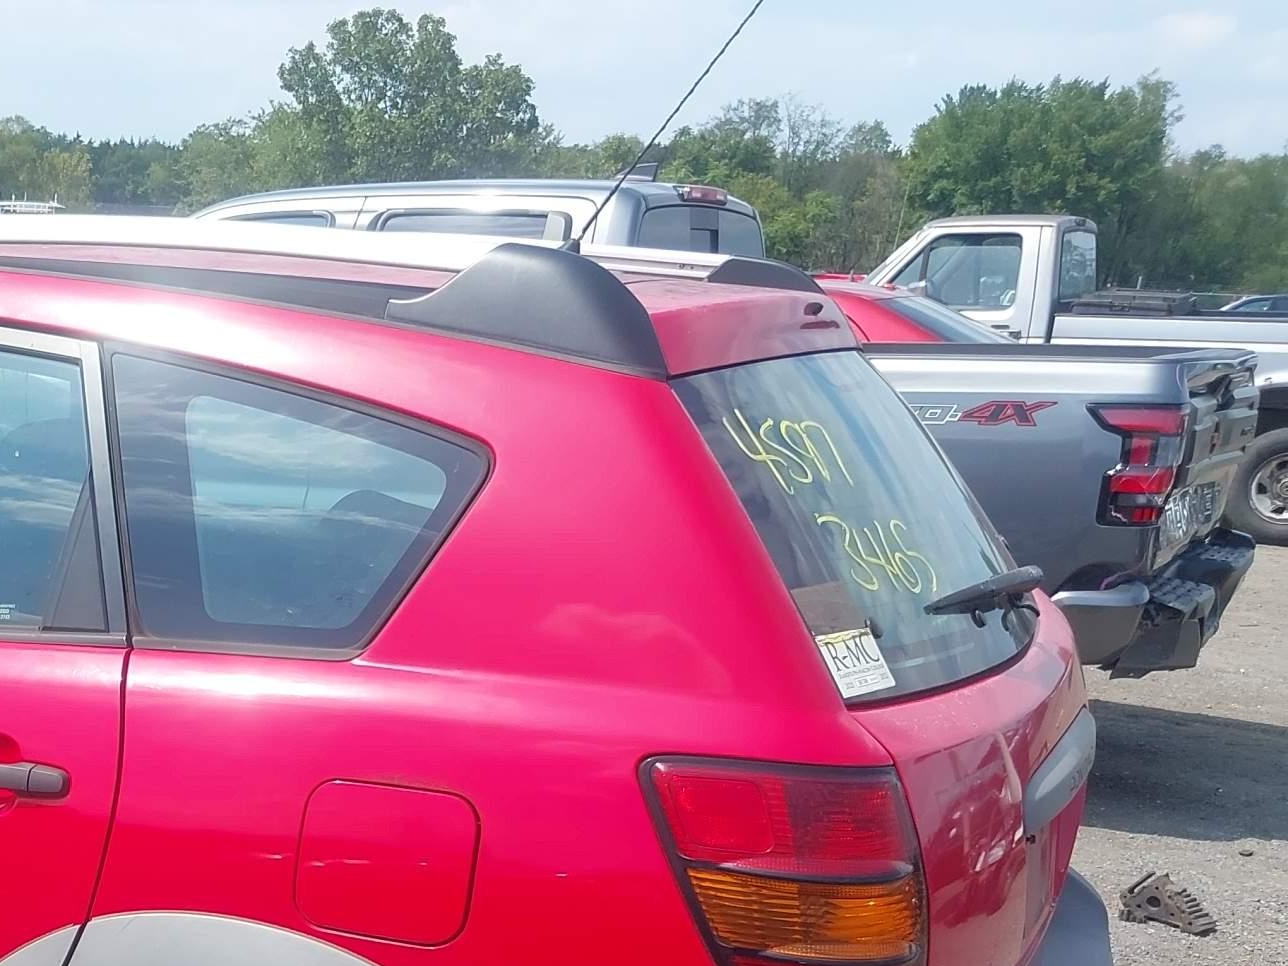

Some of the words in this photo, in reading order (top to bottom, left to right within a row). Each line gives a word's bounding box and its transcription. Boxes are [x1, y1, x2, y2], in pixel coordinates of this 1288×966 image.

[722, 408, 855, 496] 4597
[814, 512, 938, 595] 3465
[824, 632, 880, 672] R-MC
